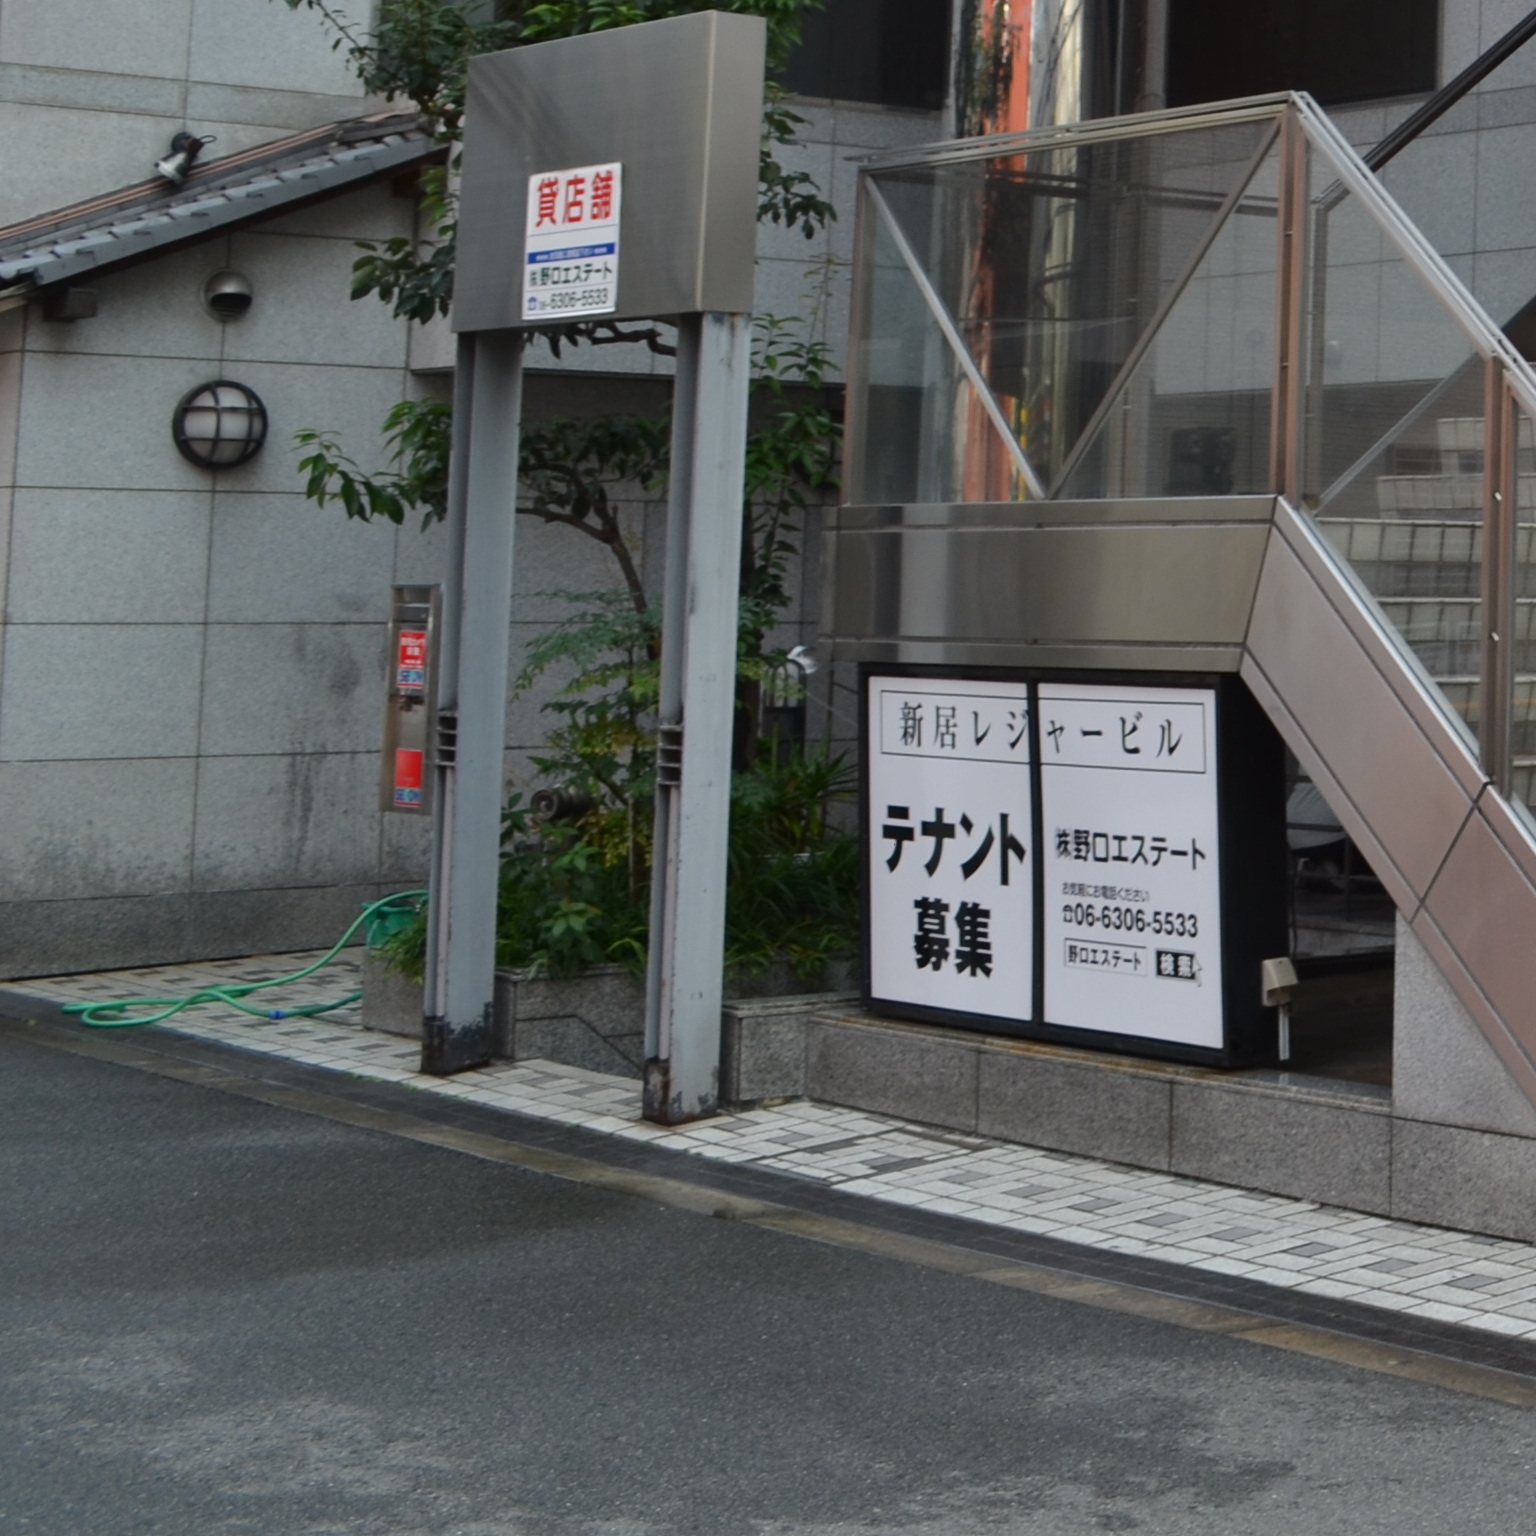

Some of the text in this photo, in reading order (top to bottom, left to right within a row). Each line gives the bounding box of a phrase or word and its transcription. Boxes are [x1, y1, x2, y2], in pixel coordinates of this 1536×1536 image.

[534, 169, 615, 228] 貸店舗
[899, 701, 1183, 759] 新居レジャービル
[881, 804, 1026, 886] テナント
[913, 896, 993, 979] 募集
[1074, 902, 1199, 939] 06-6306-5533
[1068, 944, 1142, 972] 野口エステート
[1159, 952, 1196, 978] 検索
